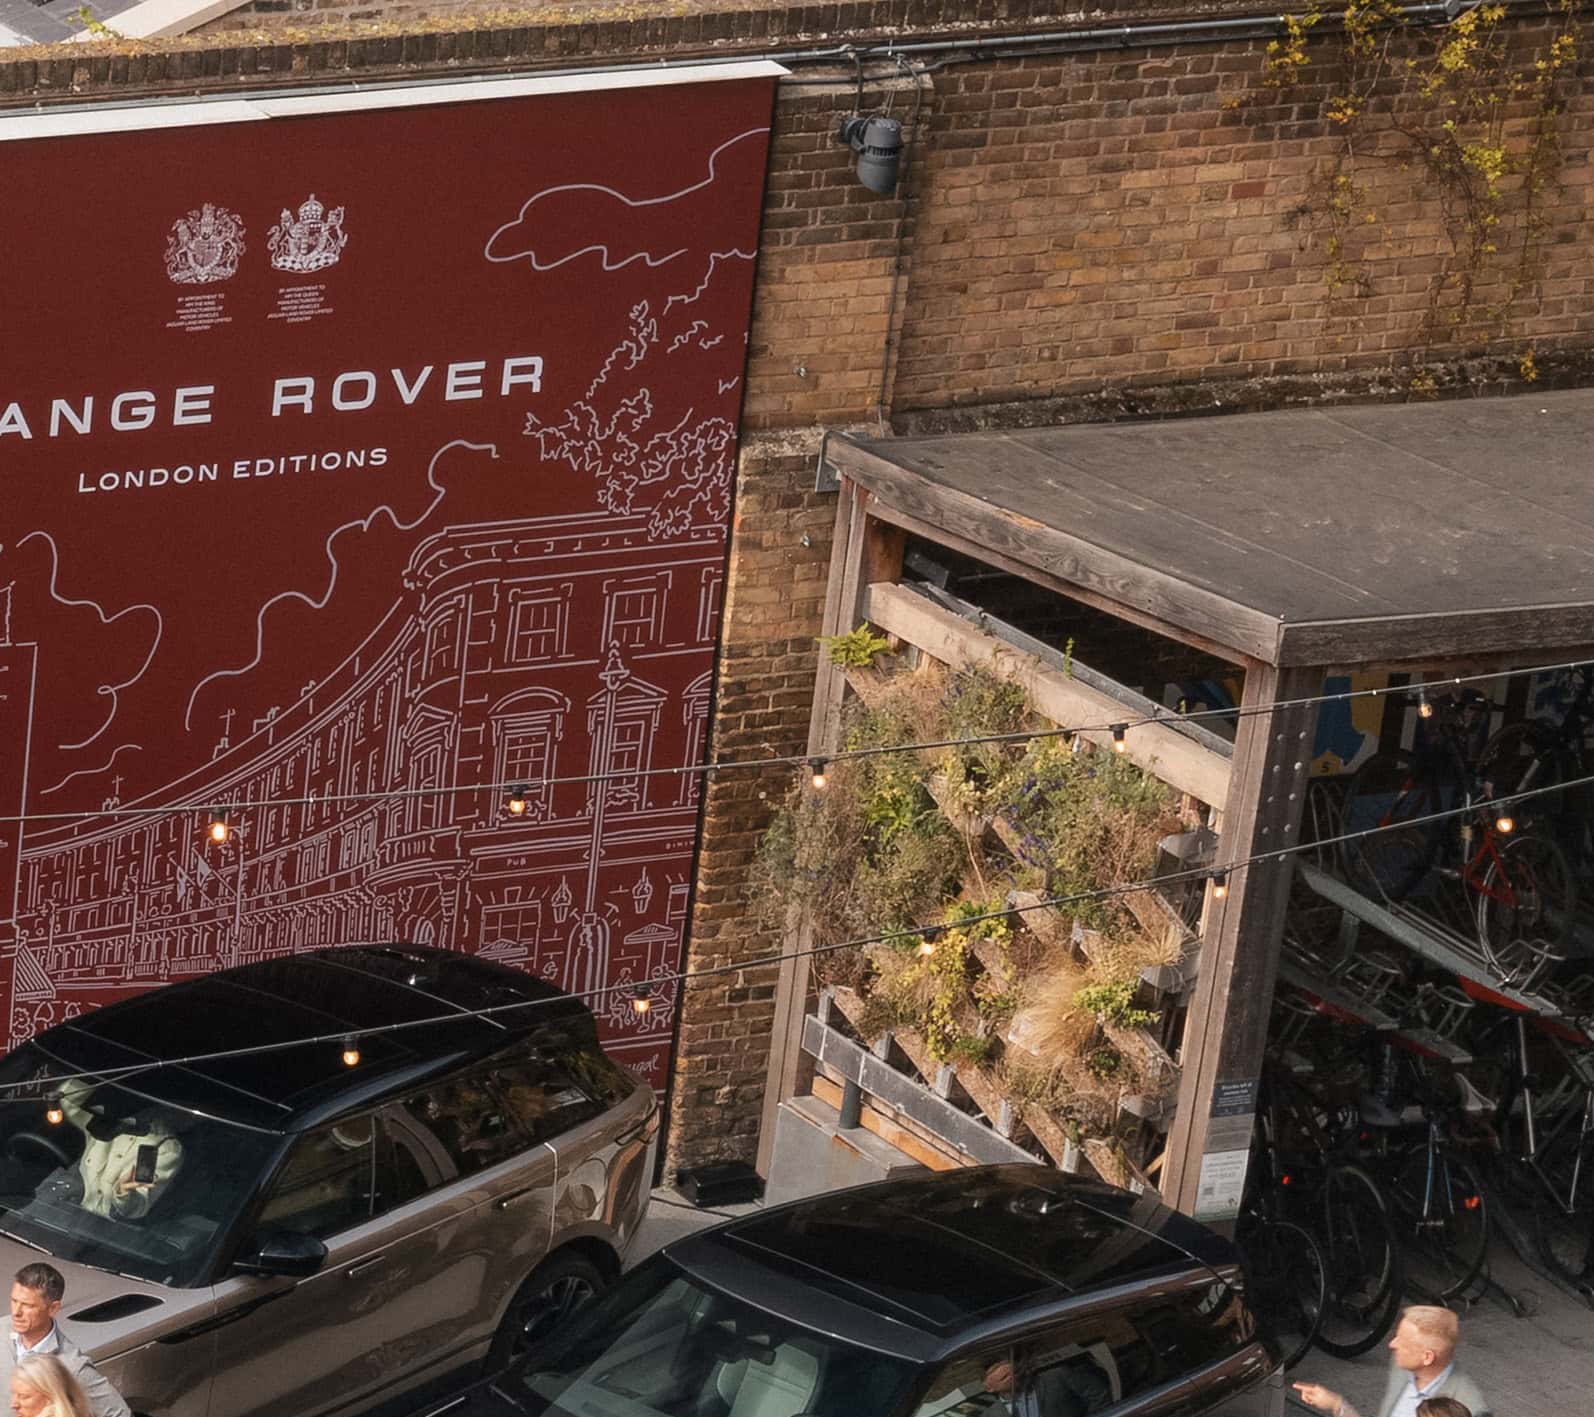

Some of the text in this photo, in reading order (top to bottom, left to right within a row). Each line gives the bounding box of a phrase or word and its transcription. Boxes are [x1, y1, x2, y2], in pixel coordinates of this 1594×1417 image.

[272, 356, 544, 416] ROVER
[78, 447, 389, 492] LONDON EDITIONS
